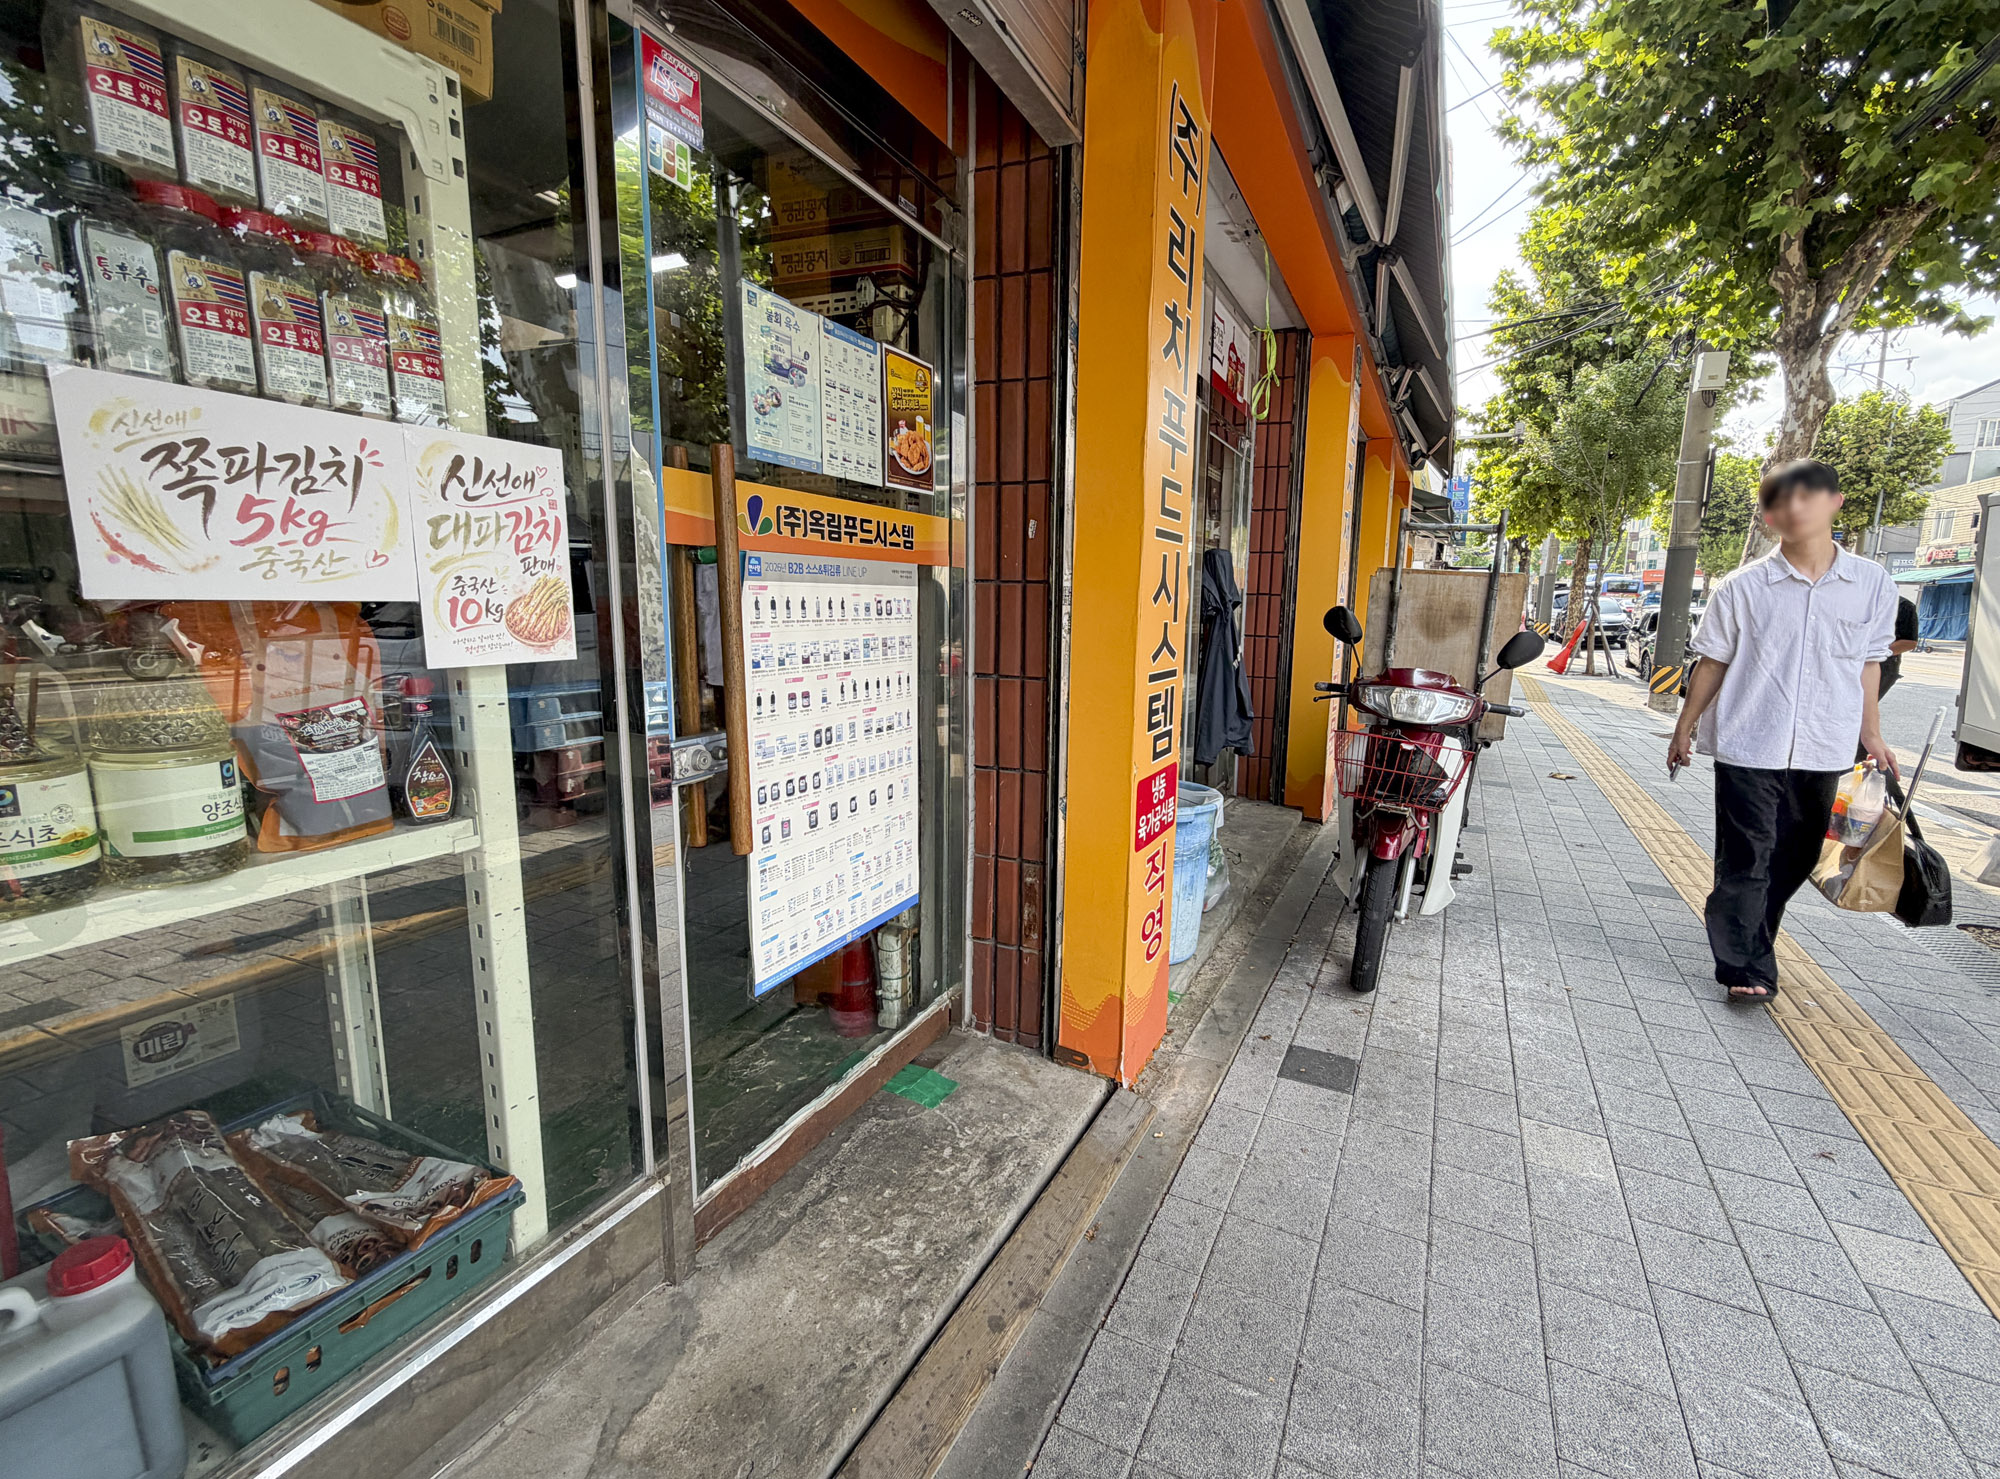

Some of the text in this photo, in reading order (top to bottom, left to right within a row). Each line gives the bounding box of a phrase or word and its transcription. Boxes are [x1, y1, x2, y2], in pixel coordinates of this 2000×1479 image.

[94, 74, 165, 113] 오토 후추
[139, 81, 162, 97] OTTO
[186, 109, 248, 146] 오토 후추
[226, 116, 246, 131] OTTO
[265, 138, 319, 170] 오토 후추
[299, 143, 317, 156] OTTO
[649, 136, 688, 173] JCB
[329, 166, 379, 194] 오토 후추
[360, 169, 377, 181] OTTO
[95, 255, 153, 289] 통후추
[175, 256, 195, 266] OTTO
[185, 306, 247, 334] 오토 후추
[224, 308, 244, 319] OTTO
[765, 307, 782, 327] 물회
[784, 316, 801, 334] 육수
[266, 326, 321, 352] 오토 후추
[301, 327, 319, 337] OTTO
[335, 341, 384, 365] 오토 후추
[397, 356, 425, 373] 오토
[111, 407, 190, 433] 신선애
[141, 437, 367, 540] 쪽파김치
[440, 454, 536, 502] 신선애
[230, 493, 350, 548] 5kg
[775, 504, 915, 551] (주)옥림푸드시스템
[239, 548, 352, 582] 중국산
[519, 556, 556, 577] 판매
[788, 563, 804, 575] B2B
[805, 564, 841, 578] 소스&튀김류
[842, 566, 857, 578] LINE
[858, 567, 868, 579] UP
[451, 575, 499, 597] 중국산
[1151, 772, 1167, 804] 냉동
[1137, 795, 1175, 842] 육가공식품
[1140, 839, 1168, 964] 직영
[138, 1029, 184, 1058] 미림
